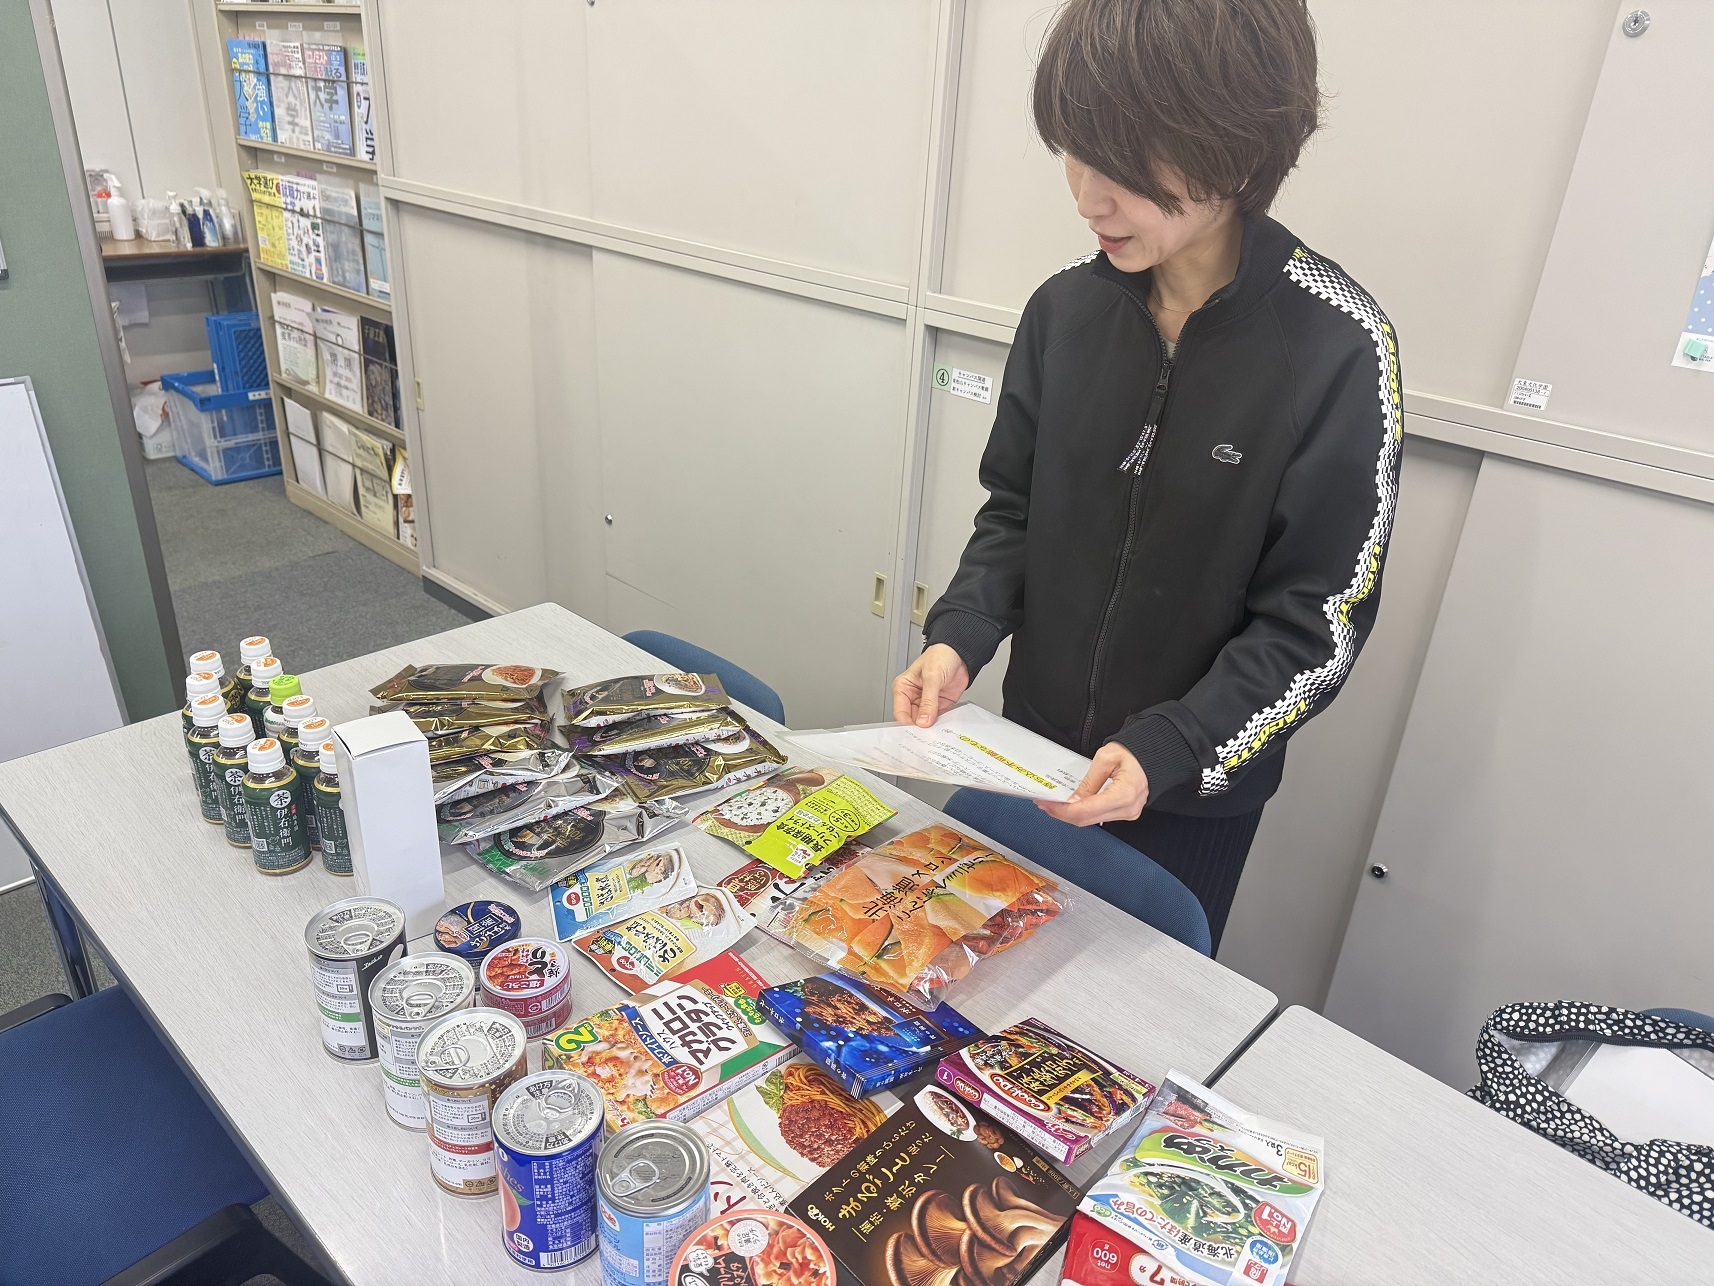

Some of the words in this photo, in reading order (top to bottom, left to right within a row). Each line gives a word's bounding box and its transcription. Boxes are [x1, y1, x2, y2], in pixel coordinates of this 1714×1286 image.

[311, 80, 339, 112] 大学
[246, 173, 275, 190] 大学選び
[1224, 699, 1308, 771] LACOSTE
[200, 748, 216, 762] 茶
[227, 770, 244, 784] 茶
[272, 791, 290, 807] 茶
[276, 808, 293, 847] 伊右衛門
[776, 822, 823, 853] 長期保存食
[786, 815, 832, 847] フリーズドライ
[824, 823, 842, 839] ごはん
[860, 854, 952, 919] 北海道メロン
[625, 920, 678, 964] さばみそ煮
[527, 948, 546, 979] とり
[502, 980, 545, 990] 塩こうじ
[677, 994, 737, 1052] グラタン
[704, 1000, 735, 1031] クイックアップ
[557, 1025, 594, 1050] 2
[631, 1019, 674, 1065] ホワイトソース
[651, 1002, 711, 1066] マカロニ
[656, 1031, 680, 1049] ハウス
[678, 1065, 699, 1086] No.1
[955, 1080, 967, 1091] Do
[992, 1074, 1014, 1092] Do
[1017, 1056, 1074, 1092] 麻婆茄子
[528, 1081, 551, 1093] あけ方
[965, 1086, 980, 1100] Cook
[1012, 1084, 1045, 1110] Cook
[547, 1136, 571, 1148] あけ方
[1194, 1138, 1235, 1155] スープ
[1259, 1137, 1284, 1157] 3袋入
[823, 1119, 916, 1202] ホクトの霜降りひらたけ
[1162, 1133, 1290, 1191] わかめ
[838, 1131, 934, 1219] まるごと使った
[748, 1167, 789, 1208] 煮込んだソース
[858, 1151, 946, 1236] 菌活・贅沢カレー
[807, 1204, 836, 1232] HOKTO
[1093, 1205, 1112, 1219] eco
[1260, 1205, 1294, 1228] No.1
[750, 1228, 759, 1246] ランチ
[1112, 1199, 1238, 1261] 北海道産ほたての旨み
[1266, 1218, 1292, 1234] 売上
[1093, 1248, 1118, 1264] 600
[1097, 1260, 1111, 1269] net
[1246, 1260, 1267, 1272] リケン
[1148, 1263, 1165, 1284] 7
